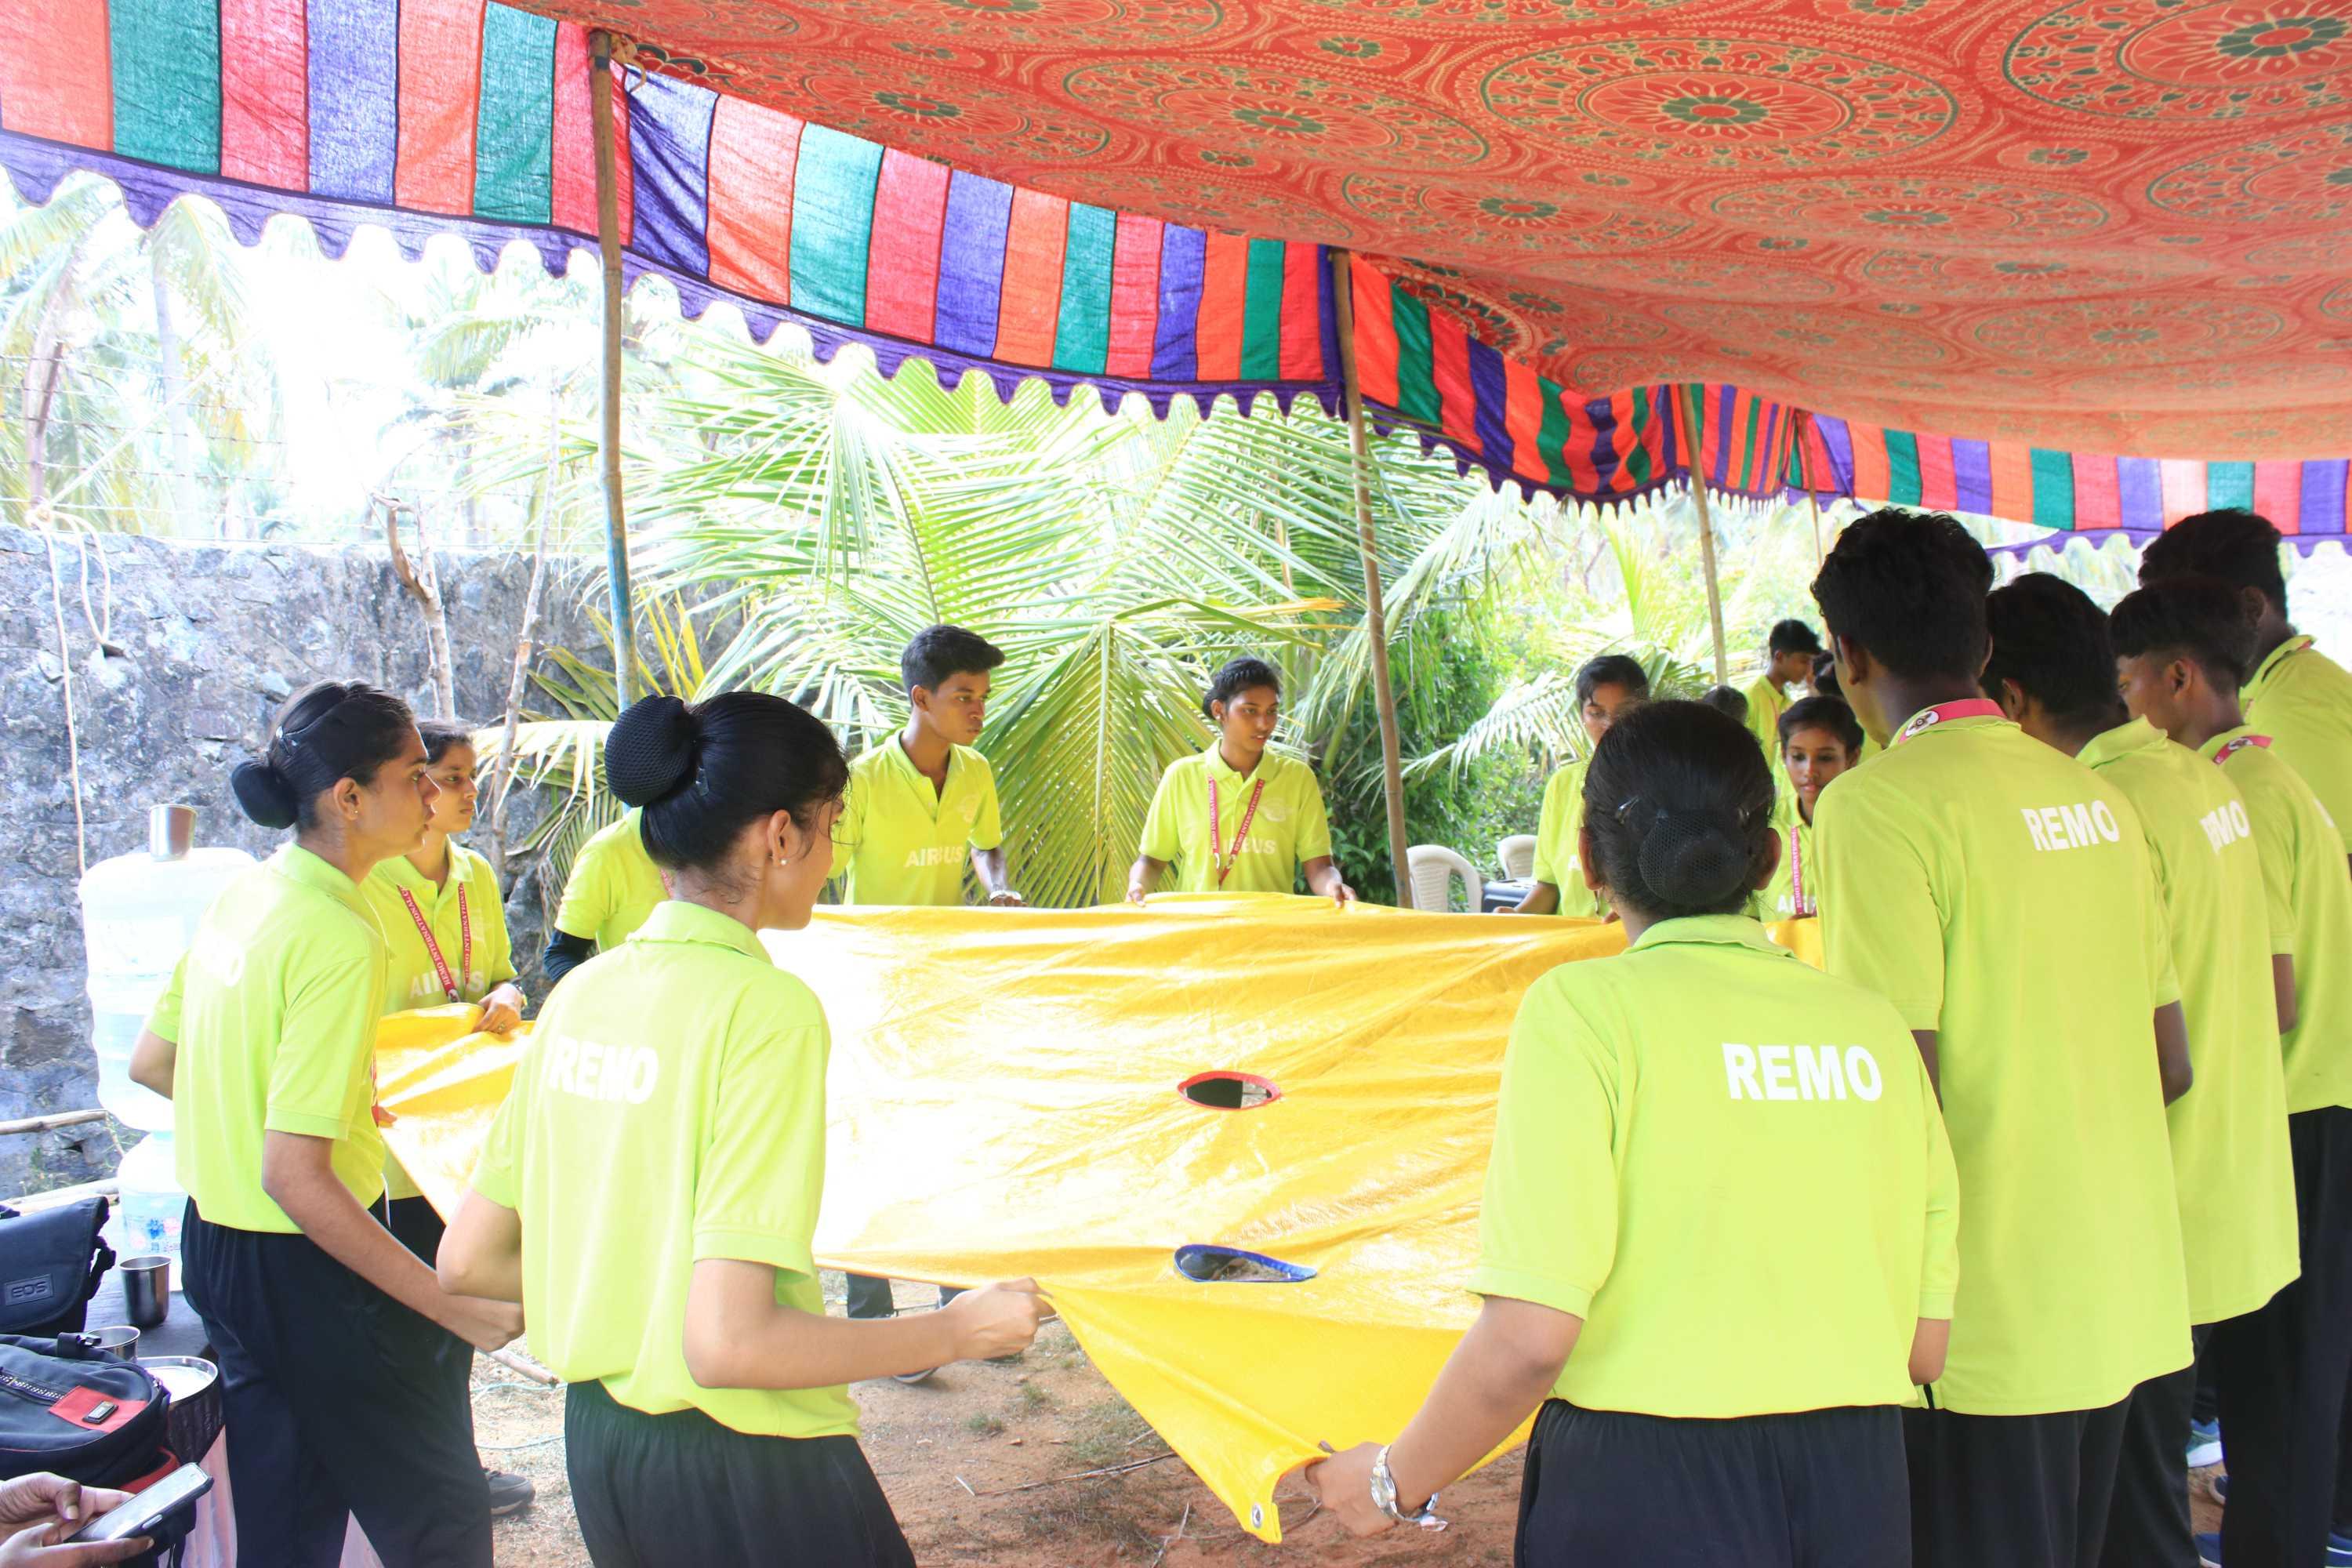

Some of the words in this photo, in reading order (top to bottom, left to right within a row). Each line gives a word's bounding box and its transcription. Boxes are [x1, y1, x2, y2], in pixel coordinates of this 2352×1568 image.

[2020, 800, 2120, 851] REMO
[2199, 800, 2249, 855] MO
[904, 847, 964, 868] AIRUS
[405, 897, 441, 962] INTERNATIONAL
[436, 961, 452, 985] REMO
[548, 1035, 659, 1105] REMO
[1722, 1043, 1882, 1102] REMO
[11, 1280, 48, 1298] EOS
